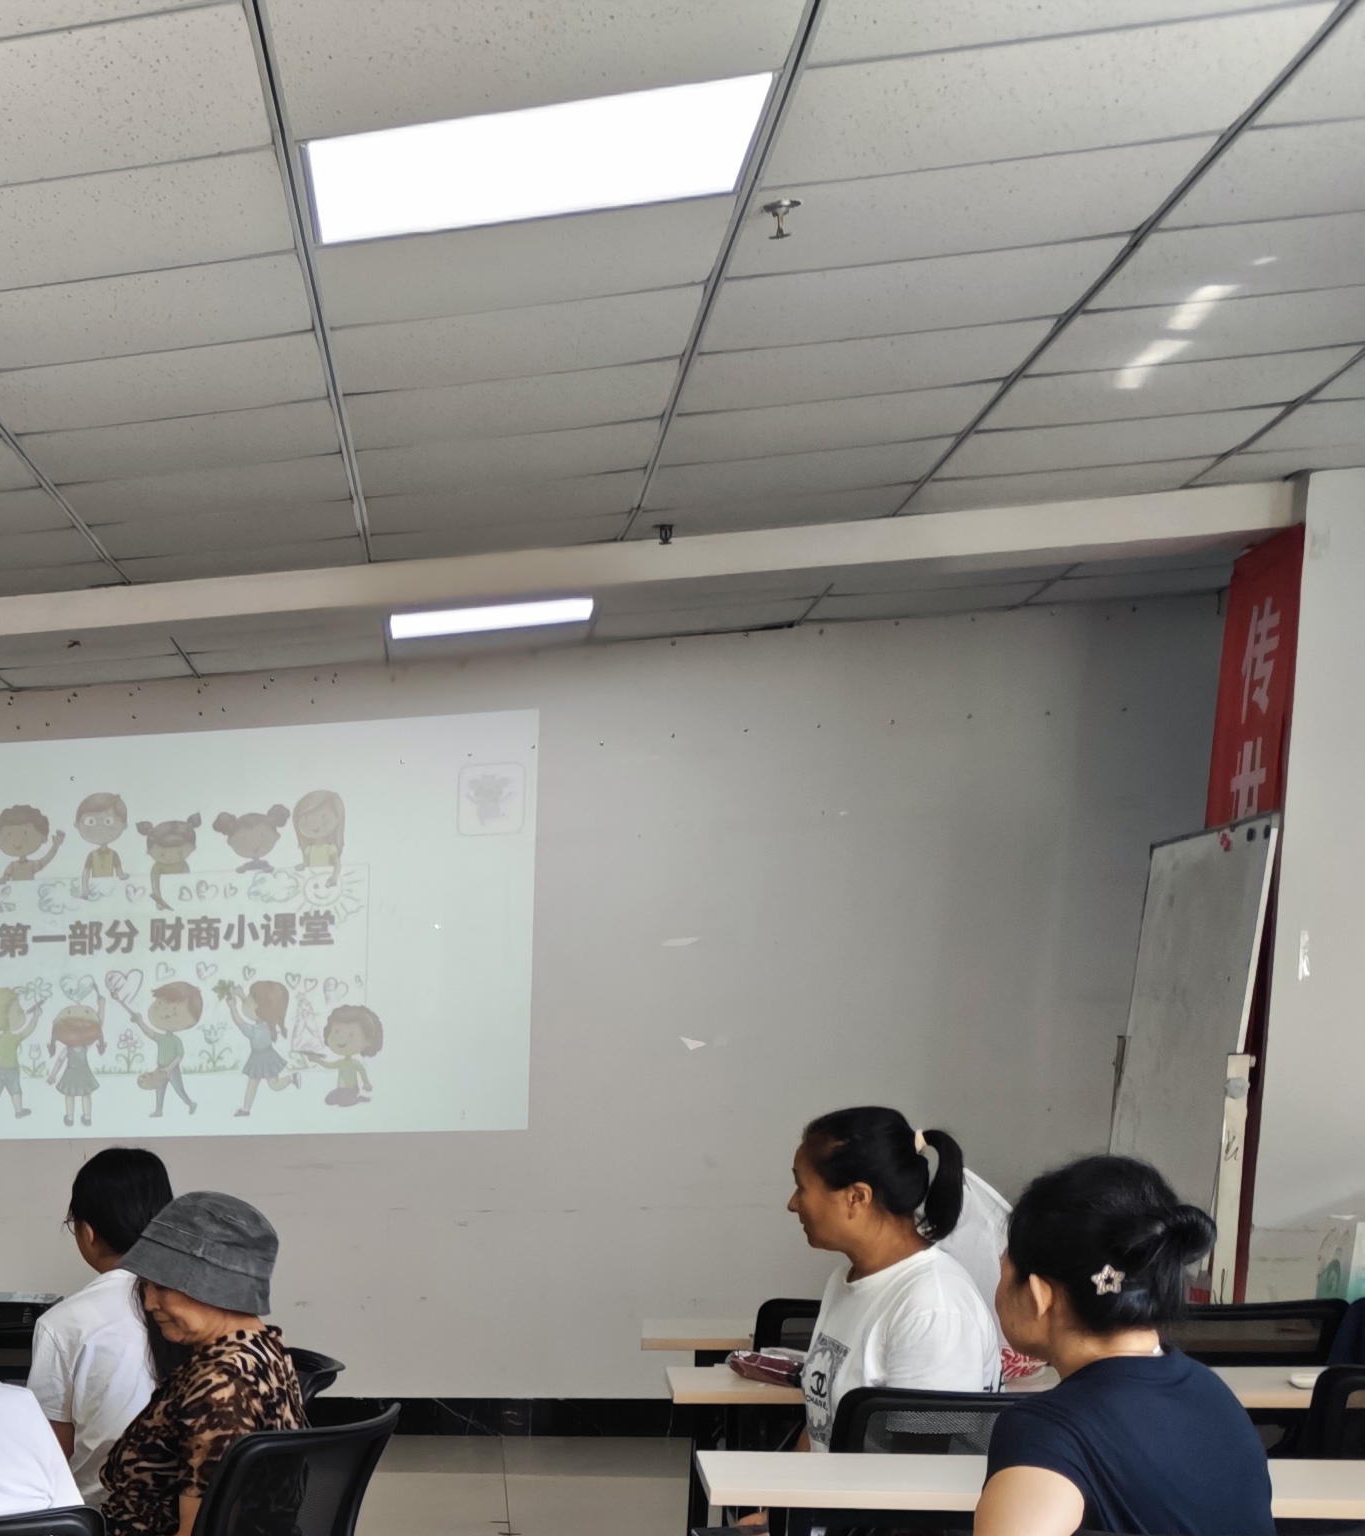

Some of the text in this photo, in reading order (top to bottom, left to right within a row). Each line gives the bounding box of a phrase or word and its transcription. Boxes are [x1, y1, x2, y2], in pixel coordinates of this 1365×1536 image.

[149, 911, 336, 952] 财商小课堂
